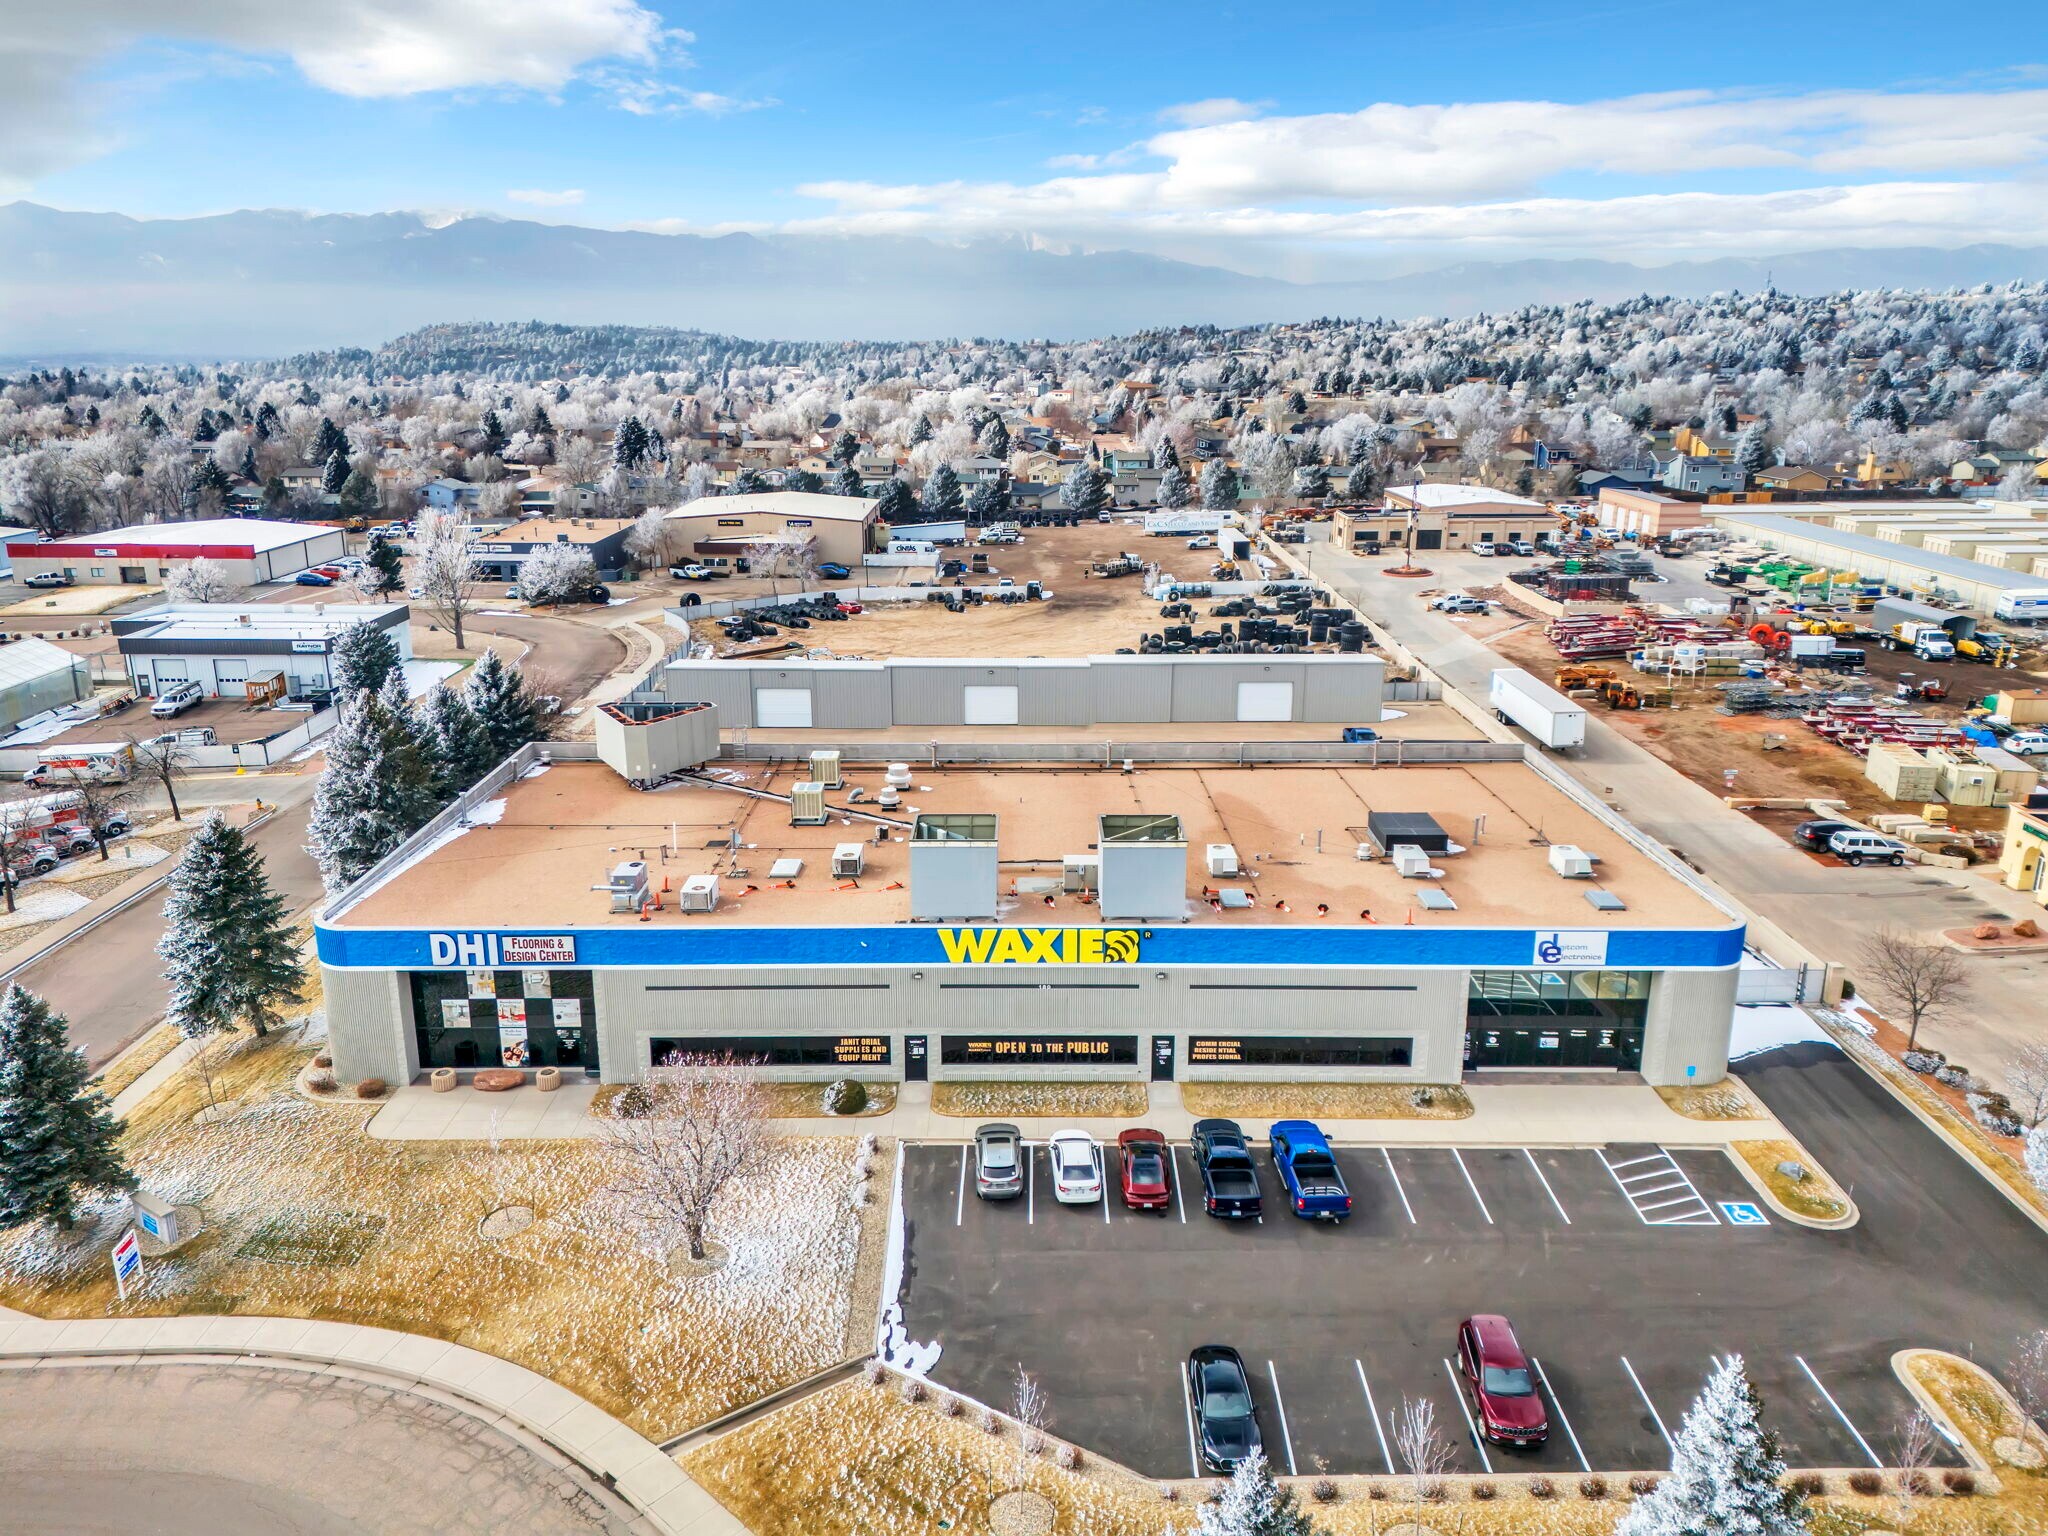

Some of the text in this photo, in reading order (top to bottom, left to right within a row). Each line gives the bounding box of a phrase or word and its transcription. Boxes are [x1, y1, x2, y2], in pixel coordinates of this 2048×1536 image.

[511, 937, 564, 949] FLOORING &
[429, 933, 500, 966] DHI
[504, 949, 574, 962] DESIGN CENTER
[995, 1042, 1109, 1054] OPEN TO THE PUBLIC
